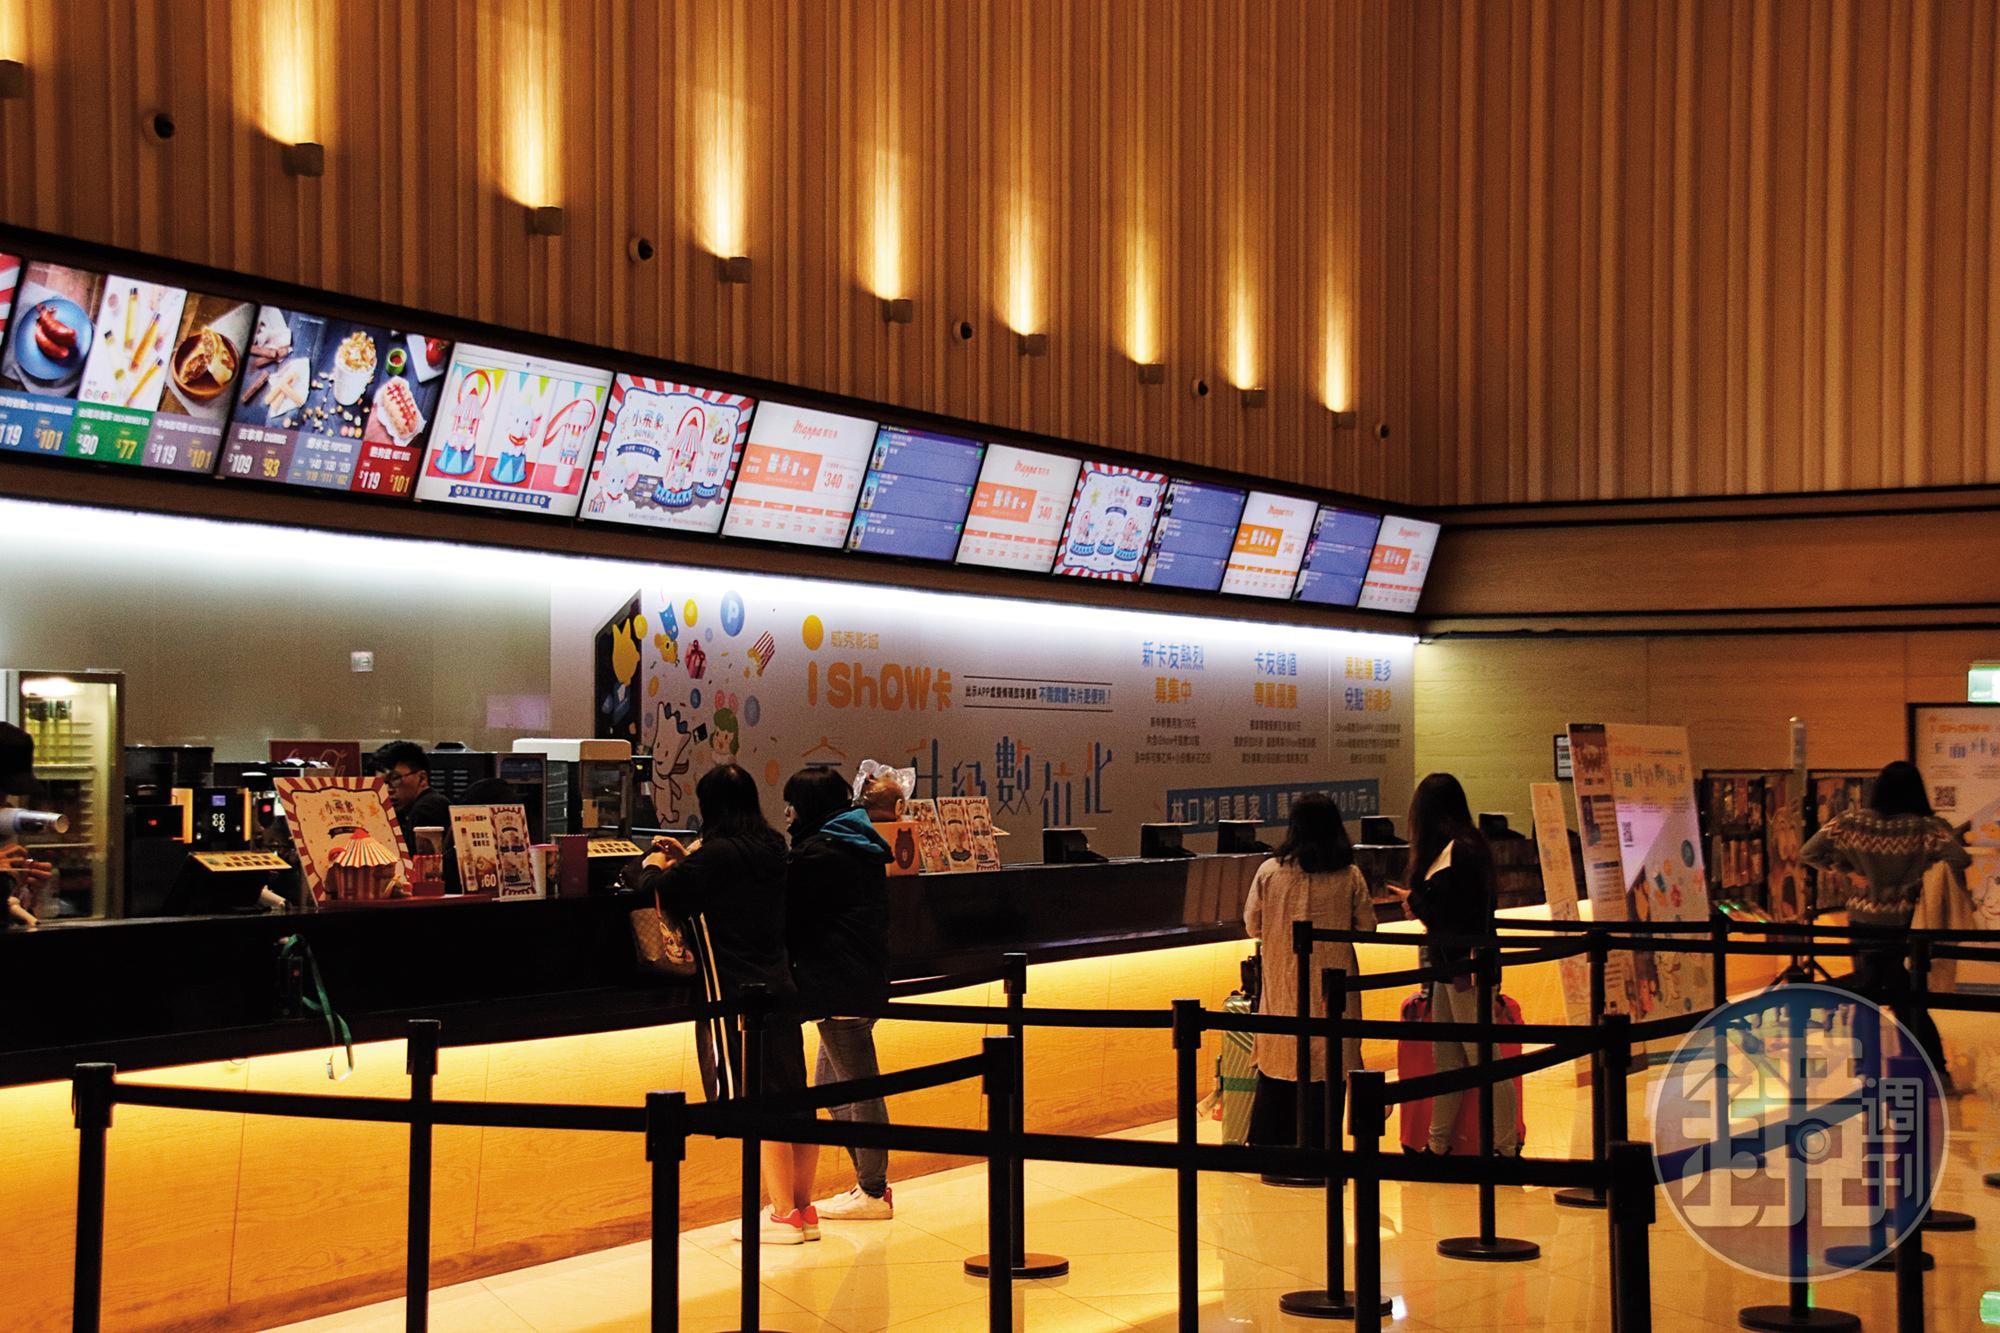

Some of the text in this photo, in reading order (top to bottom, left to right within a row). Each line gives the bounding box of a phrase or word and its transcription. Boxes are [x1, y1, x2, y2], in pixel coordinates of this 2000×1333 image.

[34, 427, 63, 451] $101
[76, 433, 99, 455] $90
[115, 438, 137, 459] $77
[151, 443, 177, 465] $119
[188, 448, 212, 469] $101
[228, 453, 253, 474] $109
[263, 458, 281, 477] $93
[360, 470, 381, 490] $119
[390, 474, 410, 493] $101
[1142, 641, 1204, 672] 新卡友熱烈
[1254, 652, 1297, 676] 卡友儲值
[1155, 677, 1192, 704] 募集中
